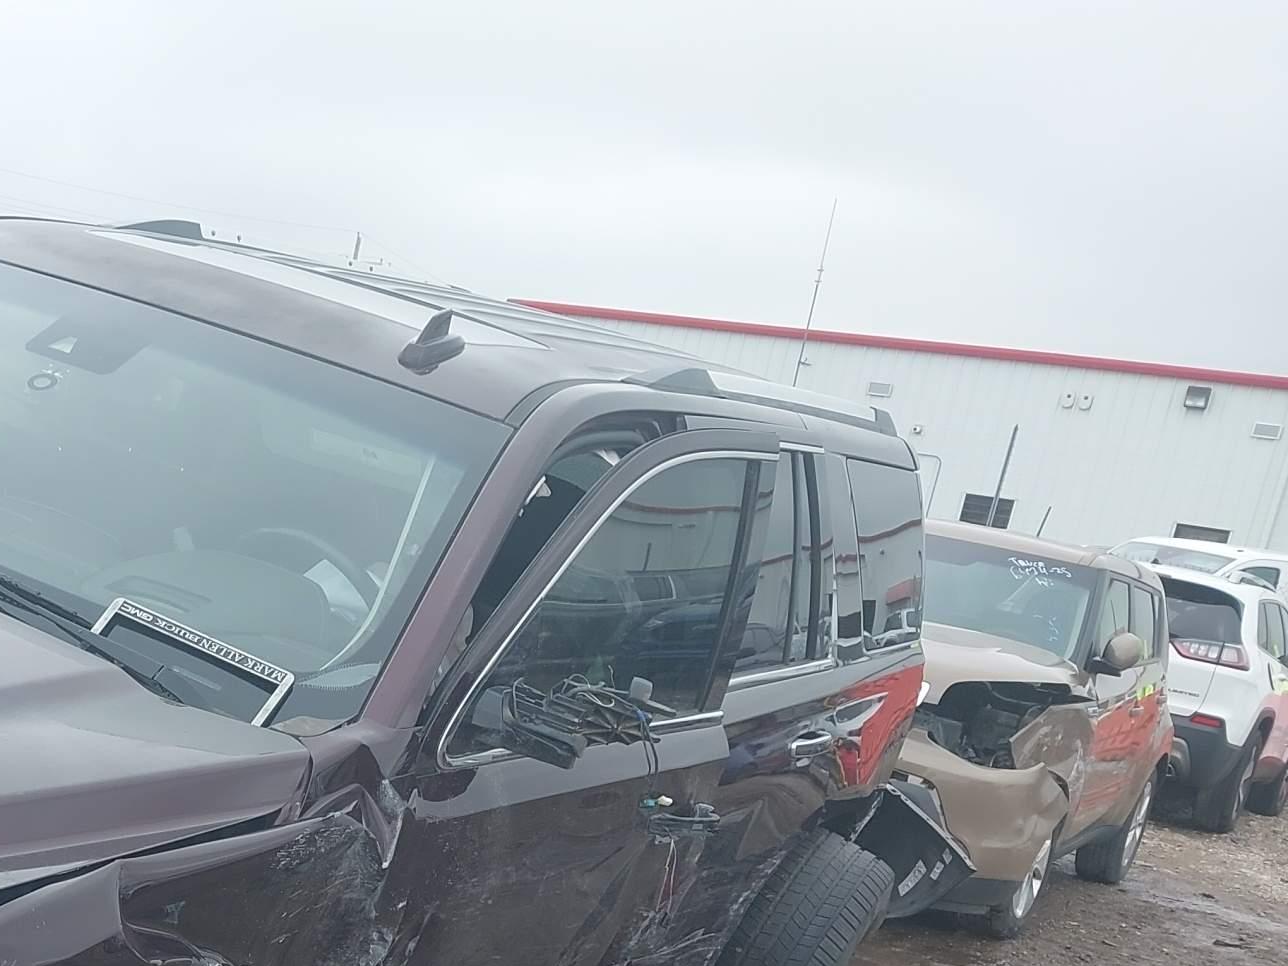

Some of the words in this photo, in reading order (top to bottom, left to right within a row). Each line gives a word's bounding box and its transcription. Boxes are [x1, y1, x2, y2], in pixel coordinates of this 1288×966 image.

[120, 602, 155, 622] GMC
[155, 616, 200, 643] BUICK
[199, 636, 247, 666] ALLEN
[243, 657, 287, 683] MARK
